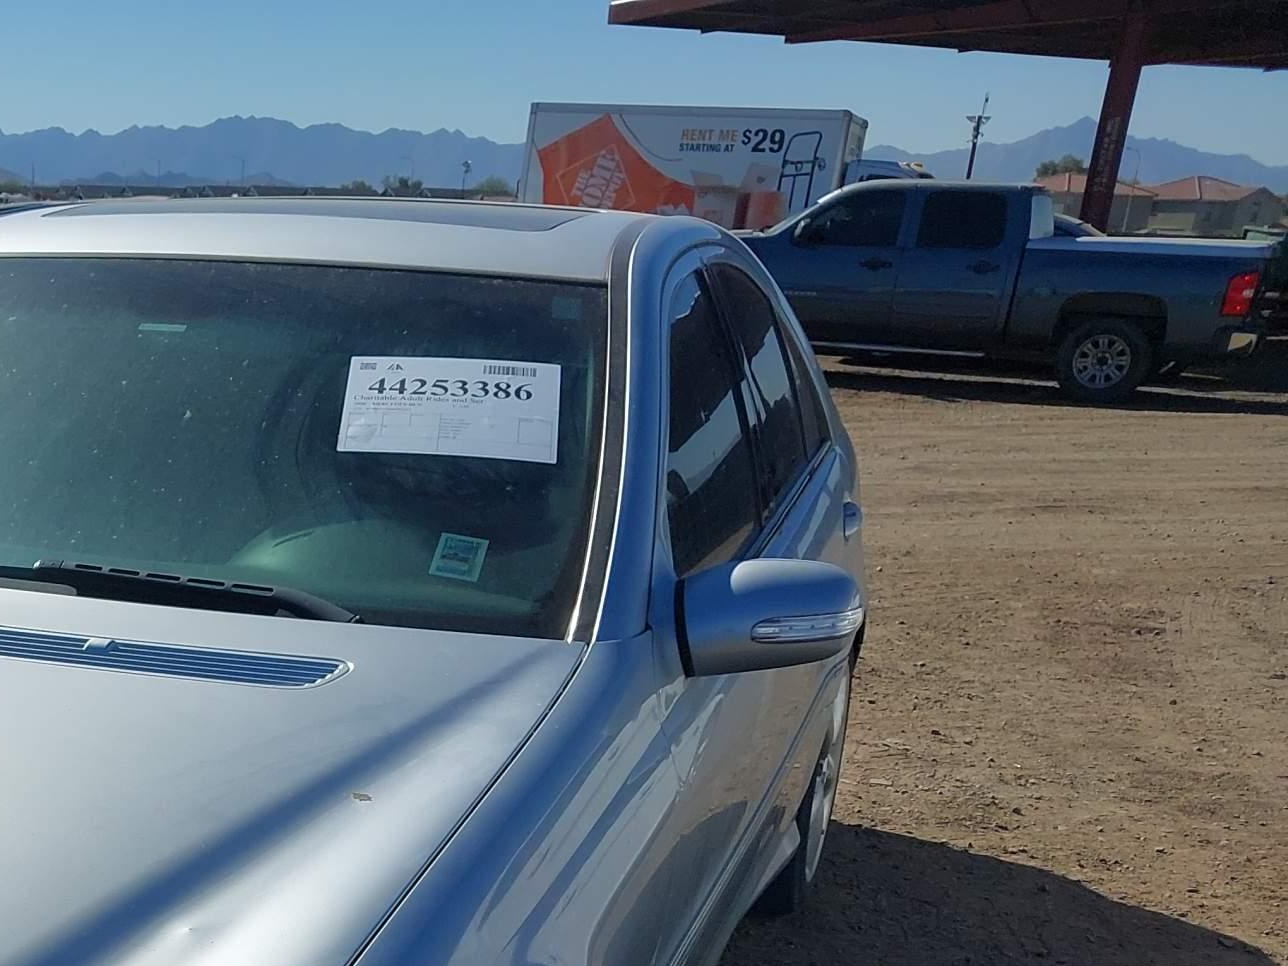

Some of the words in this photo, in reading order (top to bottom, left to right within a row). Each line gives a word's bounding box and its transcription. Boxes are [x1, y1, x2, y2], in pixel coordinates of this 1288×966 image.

[679, 142, 722, 153] STARTING
[723, 143, 736, 153] AT
[680, 128, 715, 142] RENT
[718, 128, 739, 142] ME
[741, 128, 786, 153] $29
[368, 377, 533, 401] 44253386
